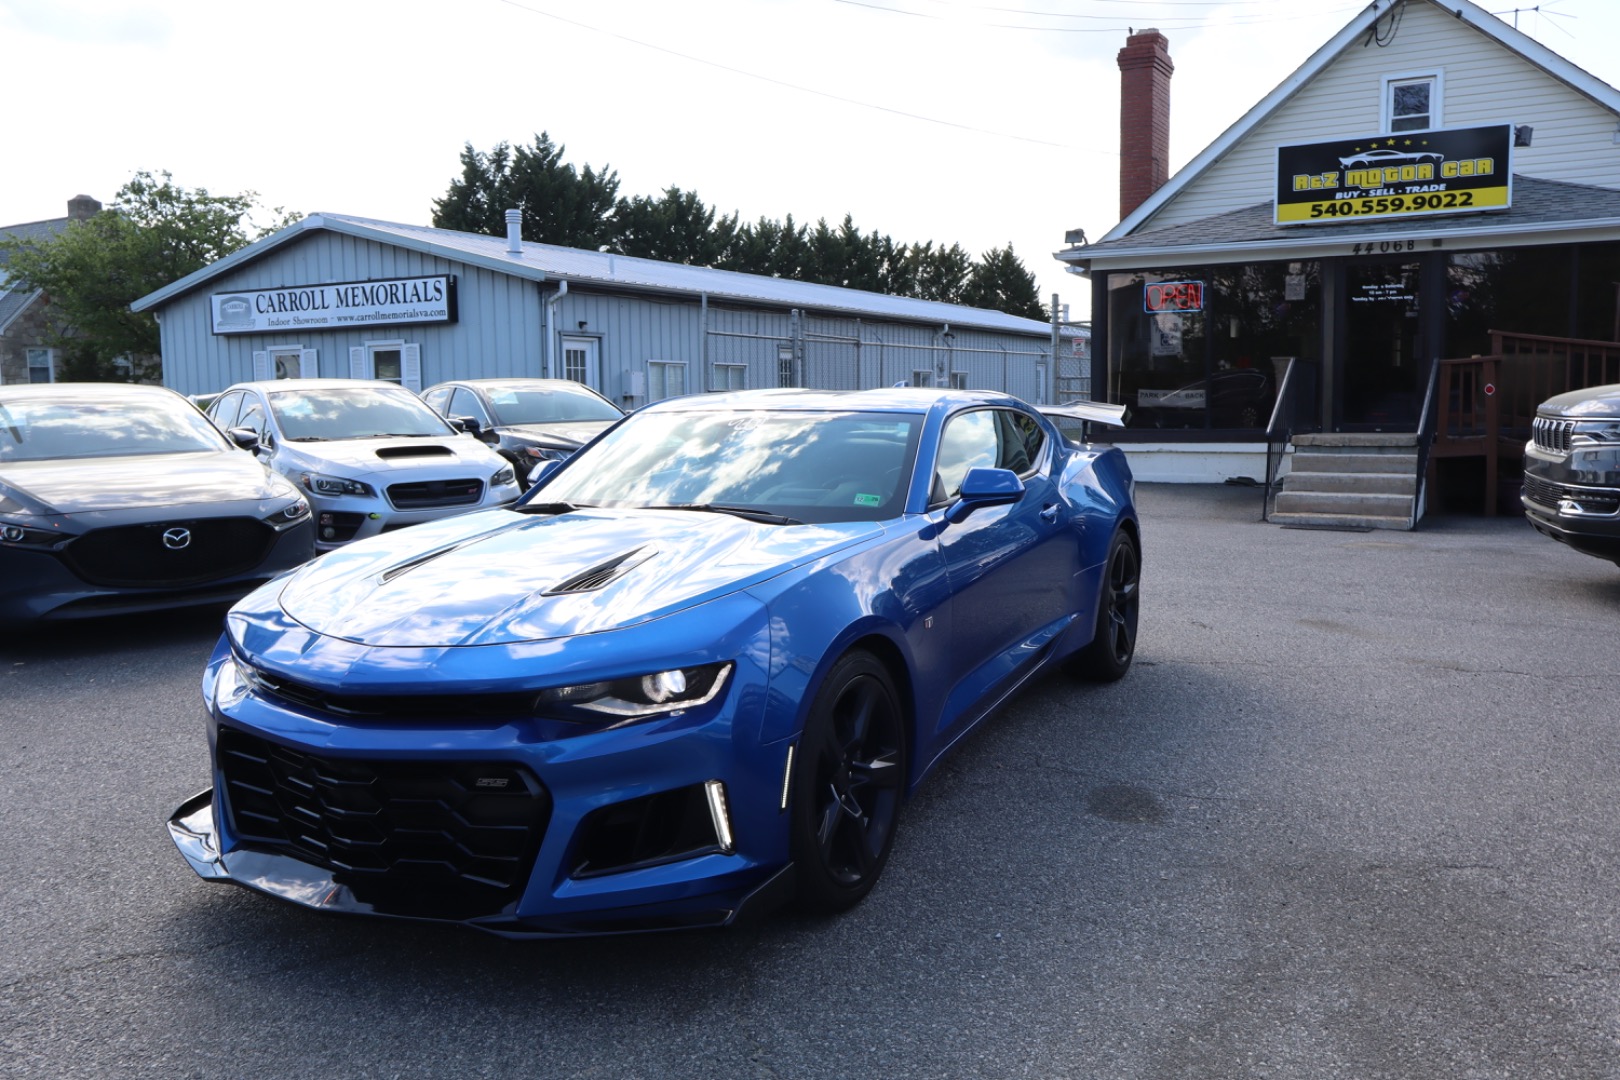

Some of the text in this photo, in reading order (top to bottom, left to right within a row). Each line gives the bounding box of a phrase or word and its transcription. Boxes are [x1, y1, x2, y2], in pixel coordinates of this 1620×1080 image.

[1335, 183, 1447, 200] BUY SELL TRADE
[1310, 192, 1473, 218] 540.559.9022
[256, 280, 443, 314] CARROLL MEMORIALS
[1147, 284, 1201, 311] OPEN
[267, 317, 291, 327] Indoor
[292, 315, 329, 325] Showroom
[336, 307, 447, 322] www.carrollmemorialsva.com
